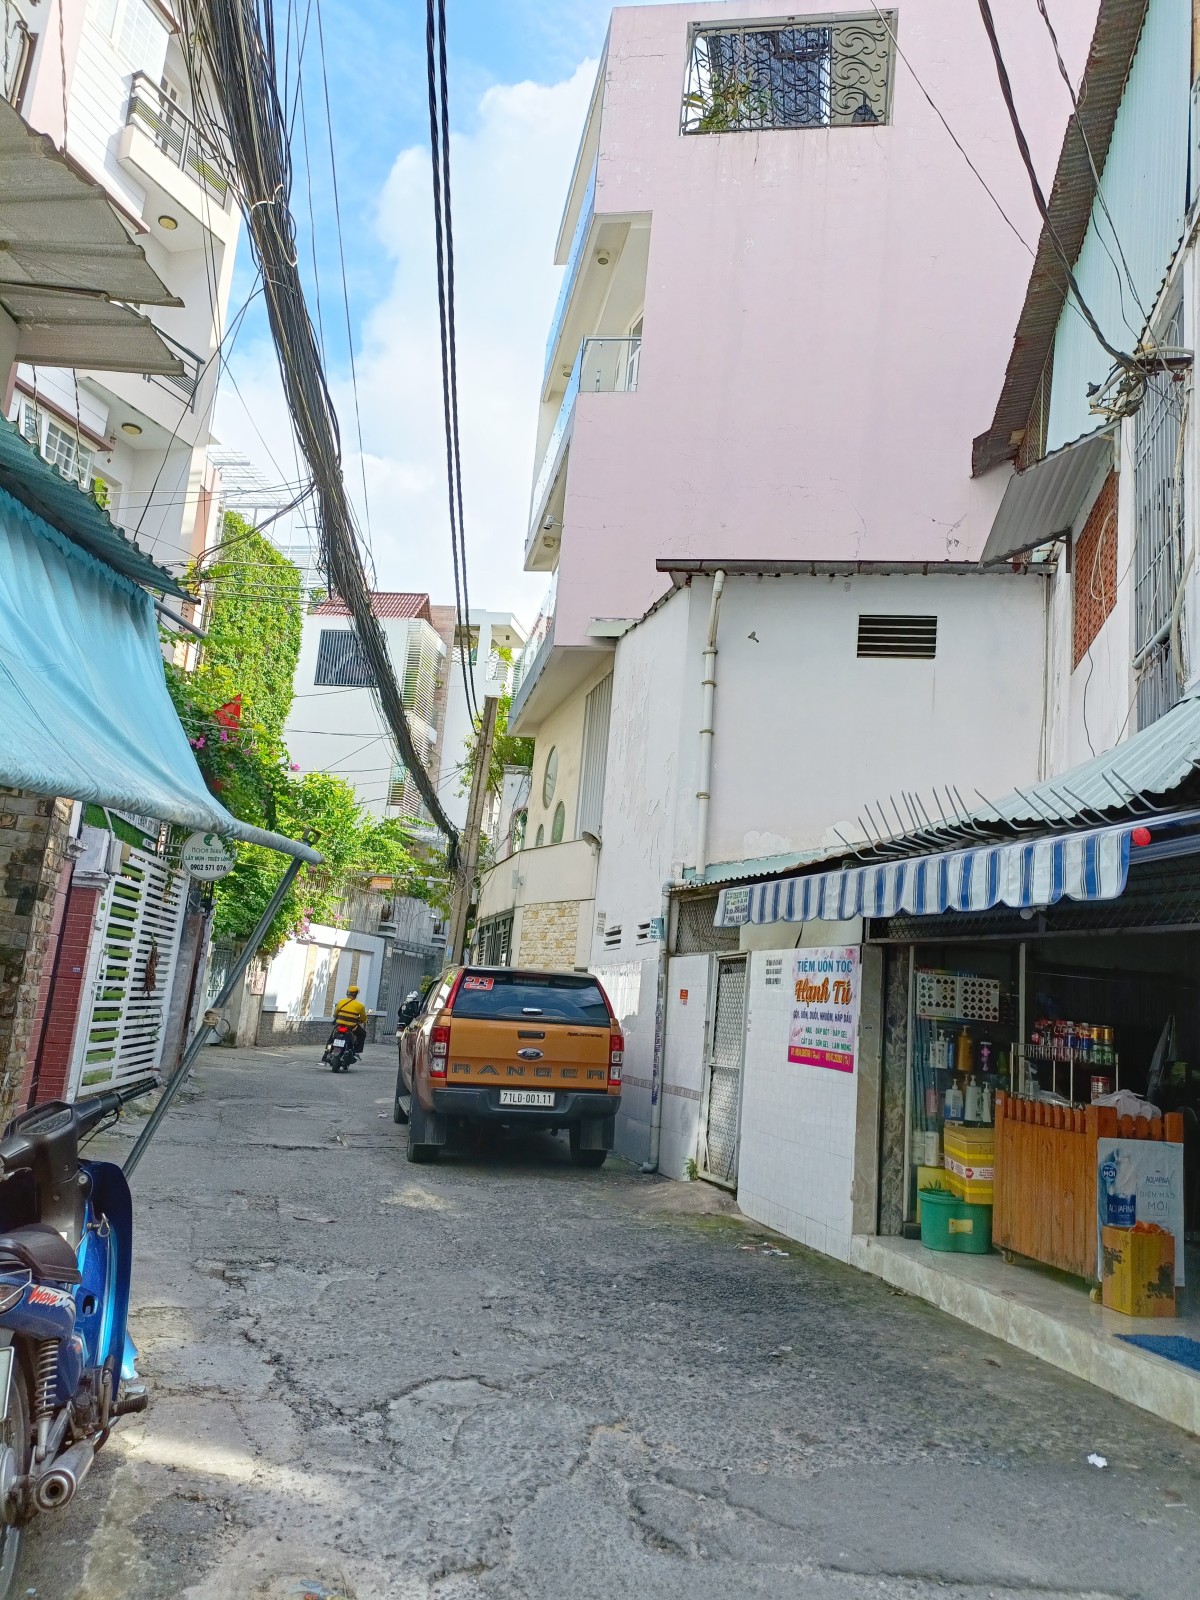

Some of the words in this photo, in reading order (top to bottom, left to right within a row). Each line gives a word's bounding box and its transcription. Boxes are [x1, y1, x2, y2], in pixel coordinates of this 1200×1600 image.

[190, 863, 204, 871] 0902
[797, 957, 815, 974] TIỆM
[817, 955, 833, 972] UỐN
[835, 957, 853, 973] TÓC
[463, 975, 495, 990] 23
[795, 976, 831, 1007] Hạnh
[451, 1063, 605, 1080] RANGER
[502, 1092, 551, 1104] 71LD-001.11
[28, 1285, 59, 1306] Wave
